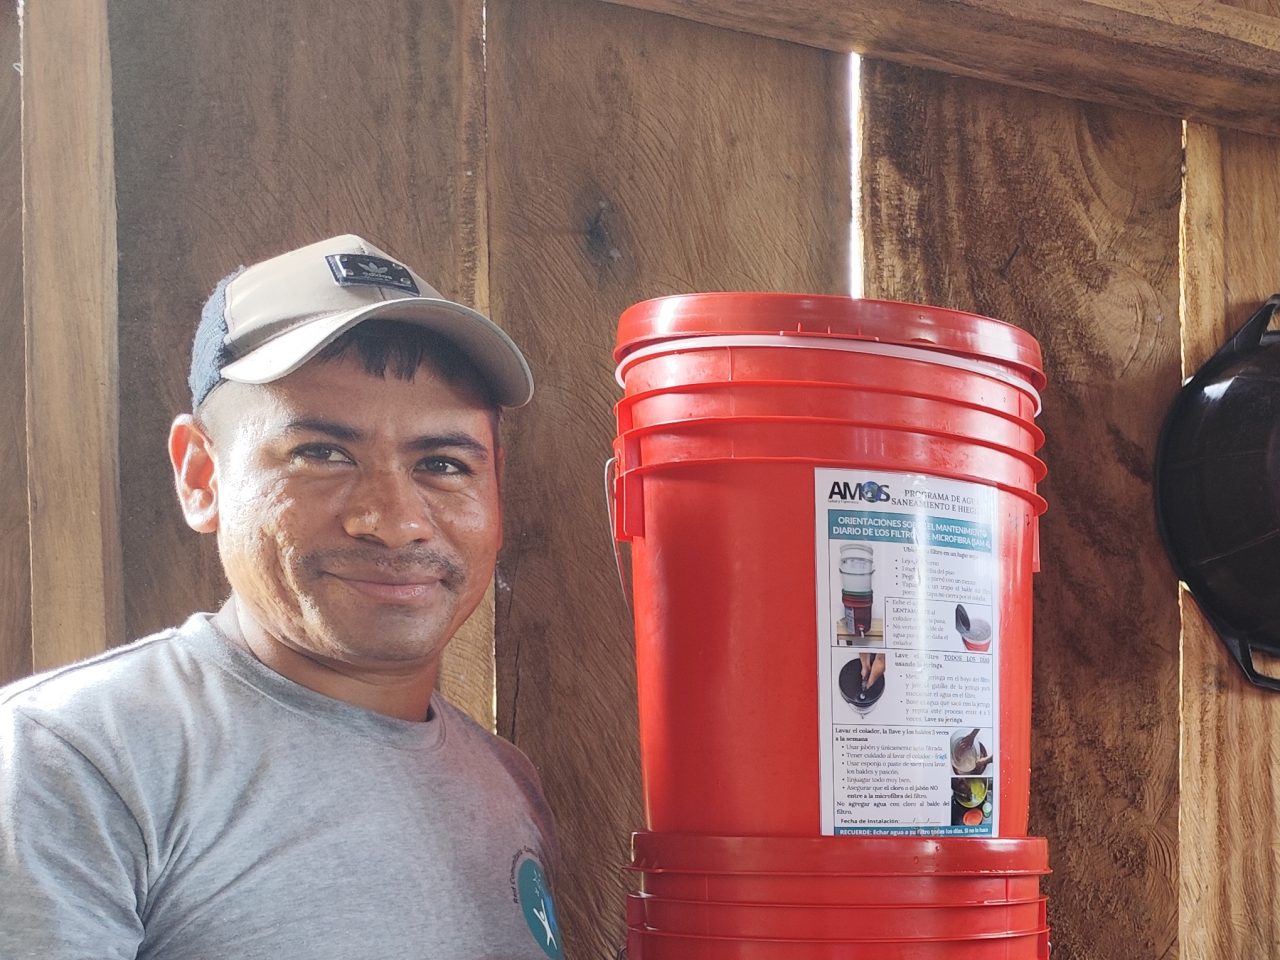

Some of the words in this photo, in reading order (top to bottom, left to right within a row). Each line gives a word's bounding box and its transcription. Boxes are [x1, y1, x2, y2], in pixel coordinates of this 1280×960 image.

[828, 481, 891, 503] AMOS
[951, 495, 961, 503] DE
[952, 504, 957, 512] E
[838, 516, 902, 527] ORIENTACIONES
[832, 526, 861, 535] DIARIO
[862, 527, 873, 536] DE
[874, 528, 889, 537] LOS
